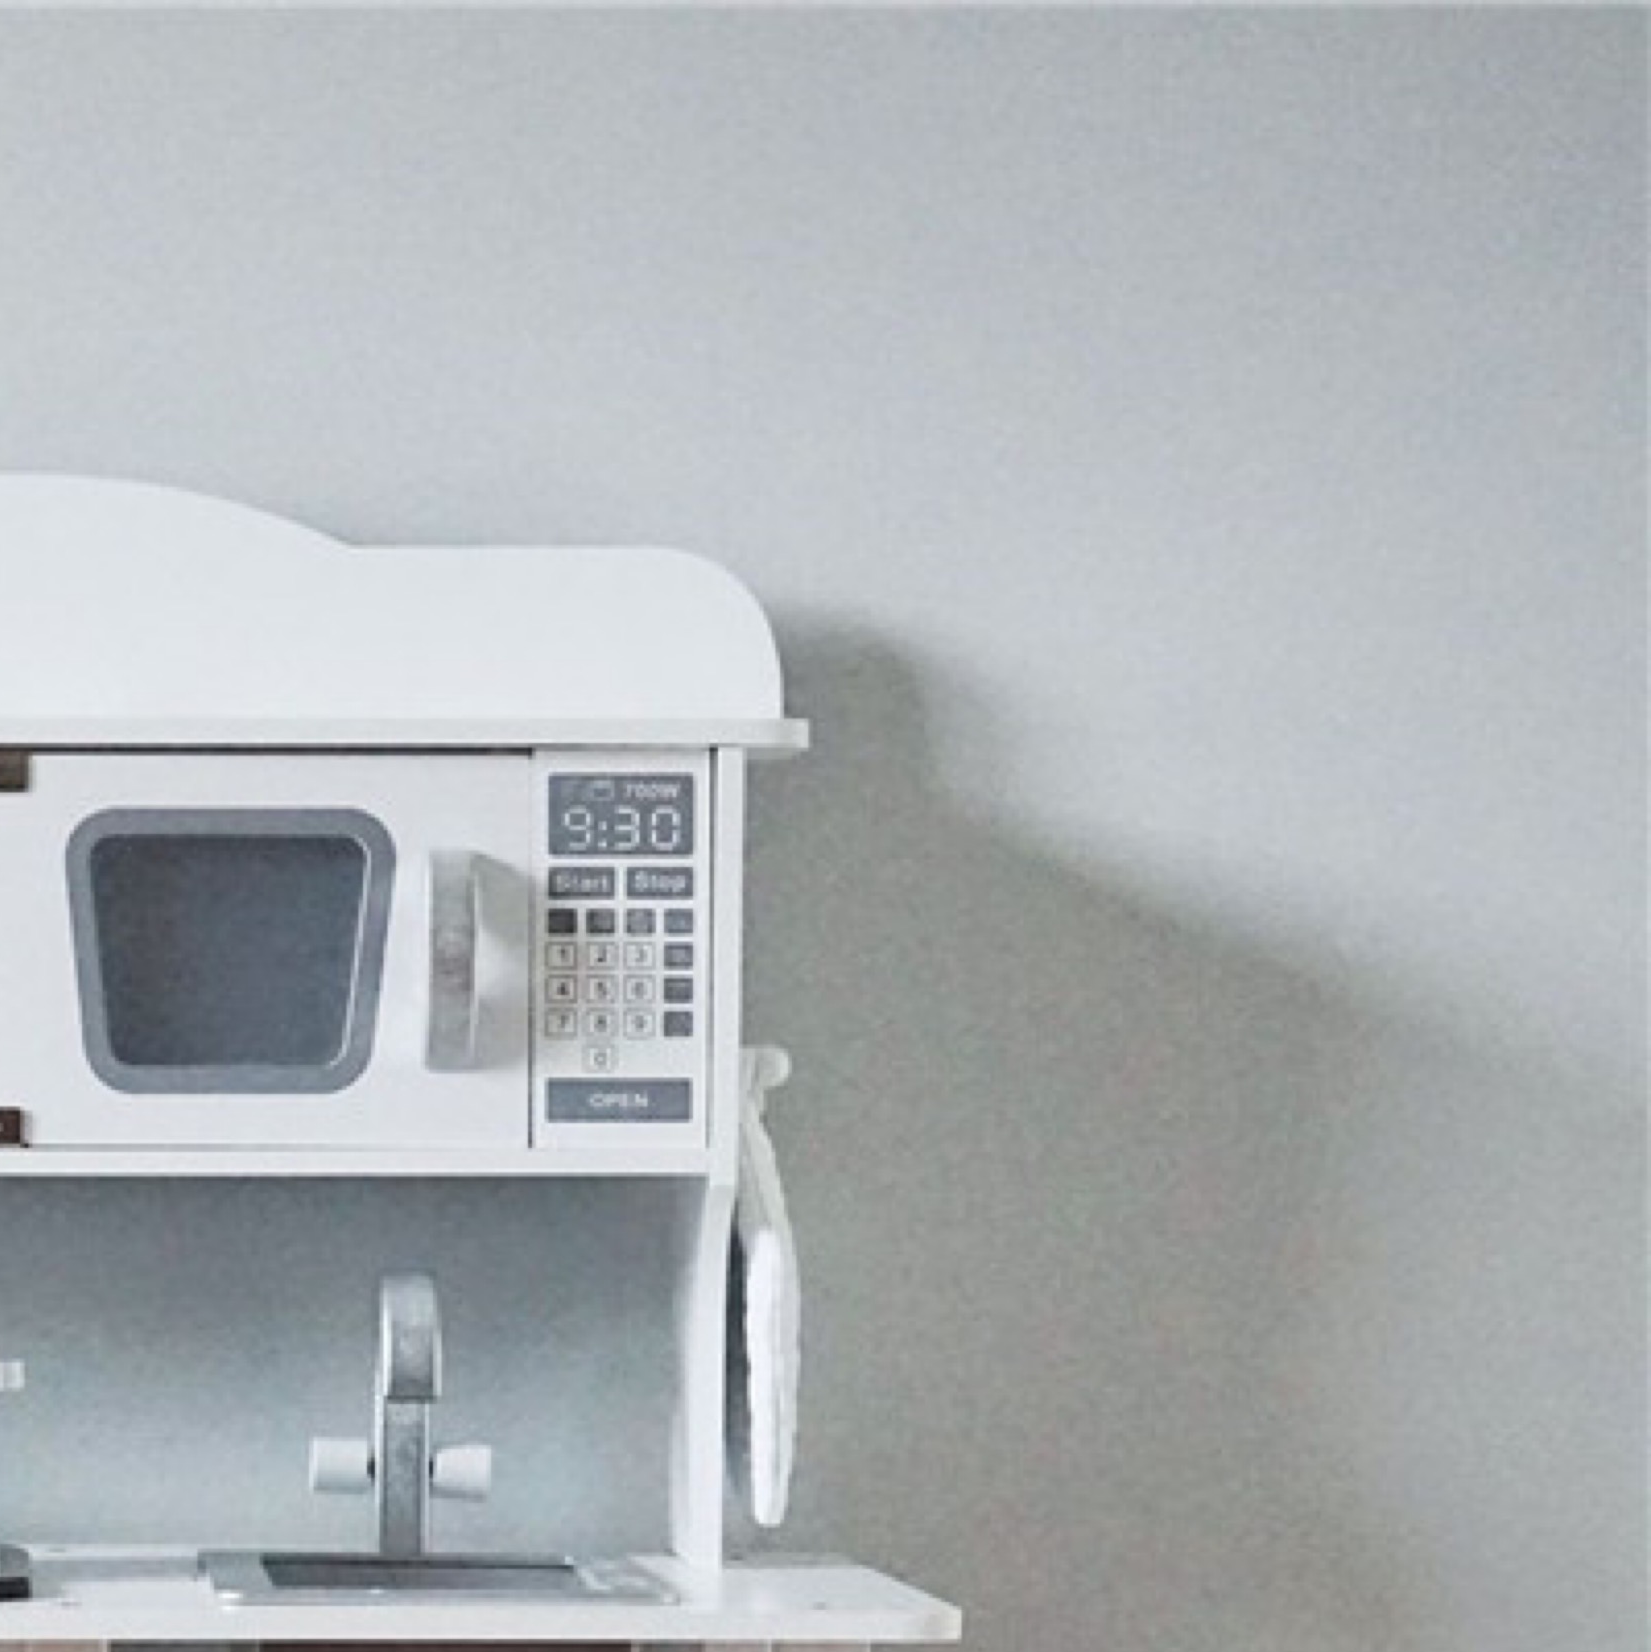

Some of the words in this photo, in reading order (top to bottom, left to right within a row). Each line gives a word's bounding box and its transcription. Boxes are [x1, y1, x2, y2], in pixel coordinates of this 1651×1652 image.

[562, 805, 681, 850] 9:30
[554, 871, 609, 893] Start
[633, 871, 687, 893] Stop
[588, 1093, 649, 1108] OPEN
